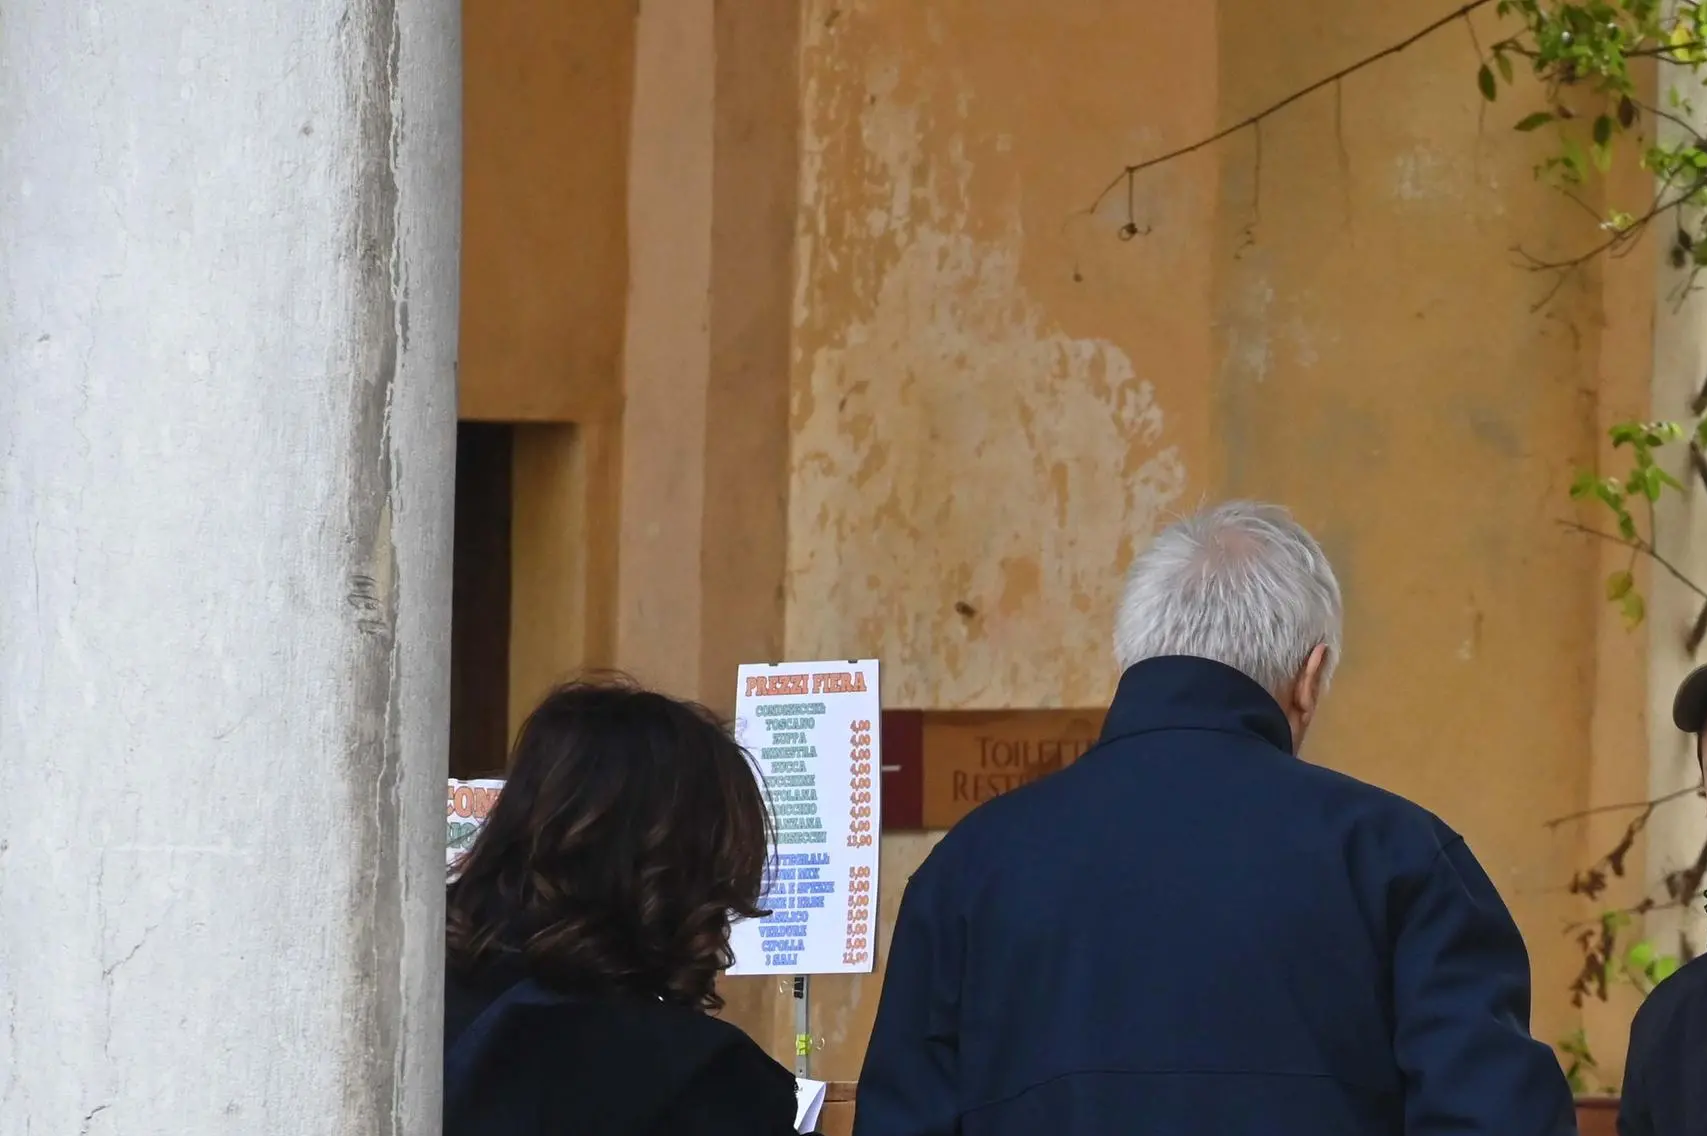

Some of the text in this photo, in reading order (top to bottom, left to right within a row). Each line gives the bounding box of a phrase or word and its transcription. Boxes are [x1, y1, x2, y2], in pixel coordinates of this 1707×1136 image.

[745, 671, 868, 697] PREZZI FIERA
[764, 717, 871, 734] TOSCANO 4,00
[772, 732, 871, 748] ZUPPA 4,00
[761, 745, 871, 762] MINESTRA 4,00
[974, 736, 1096, 770] TOILETT
[770, 760, 871, 777] ZUCCA 4,00
[849, 777, 871, 792] 4,00
[849, 791, 871, 806] 4,00
[849, 805, 871, 820] 4,00
[849, 820, 871, 834] 4,00
[849, 866, 871, 880] 5,00
[848, 880, 870, 894] 5,00
[847, 894, 869, 909] 5,00
[847, 909, 869, 922] 5,00
[758, 923, 868, 938] VERDURE 5,00
[761, 938, 867, 952] CIPOLLA 5,00
